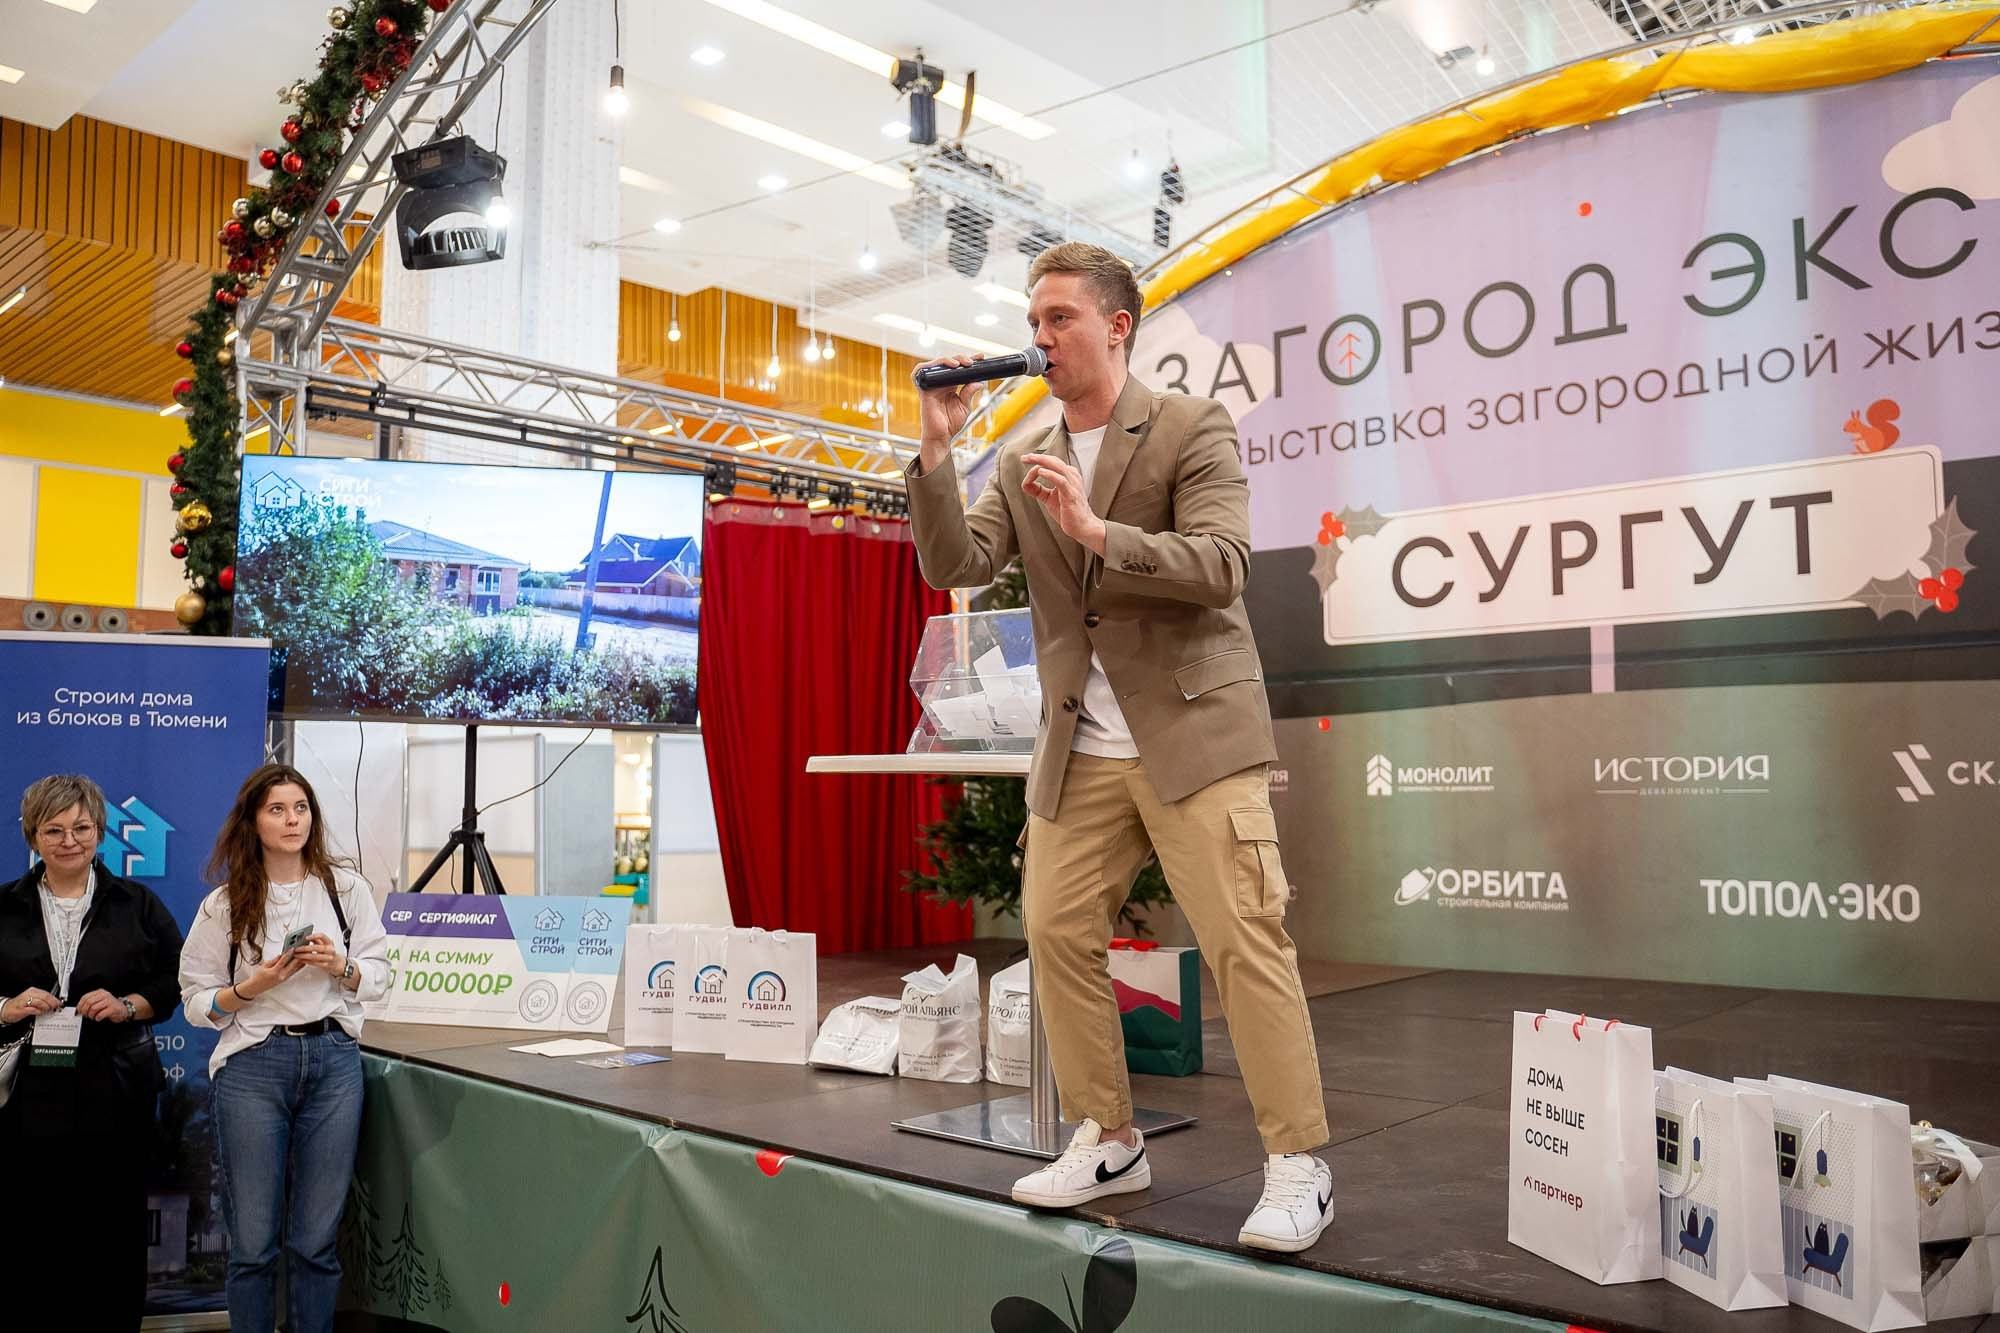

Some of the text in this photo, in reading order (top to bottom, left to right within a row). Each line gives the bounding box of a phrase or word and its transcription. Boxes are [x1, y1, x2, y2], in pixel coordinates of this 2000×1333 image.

[1156, 187, 1979, 402] ЗАГОРОД ЭКС
[1235, 405, 1446, 467] ыставка
[1467, 333, 1838, 424] загородной
[1392, 490, 1833, 608] СУРГУТ
[54, 687, 193, 707] Строим дома
[17, 709, 227, 729] из блоков в Тюмени
[1397, 766, 1494, 784] МОНОЛИТ
[1594, 755, 1770, 783] ИСТОРИЯ
[1947, 760, 2000, 785] СК
[1436, 868, 1568, 900] ОРБИТА
[390, 910, 412, 922] СЕР
[419, 912, 497, 925] СЕРТИФИКАТ
[530, 944, 566, 955] СТРОЙ
[532, 936, 560, 945] СИТИ
[579, 937, 607, 947] СИТИ
[409, 950, 493, 965] НА СУММУ
[577, 946, 613, 957] СТРОЙ
[742, 1002, 792, 1011] ГУДВИЛЛ
[1527, 1067, 1564, 1092] ДОМА
[1526, 1097, 1585, 1130] НЕ ВЫШЕ
[1525, 1128, 1569, 1157] СОСЕН
[1534, 1179, 1583, 1211] партнер
